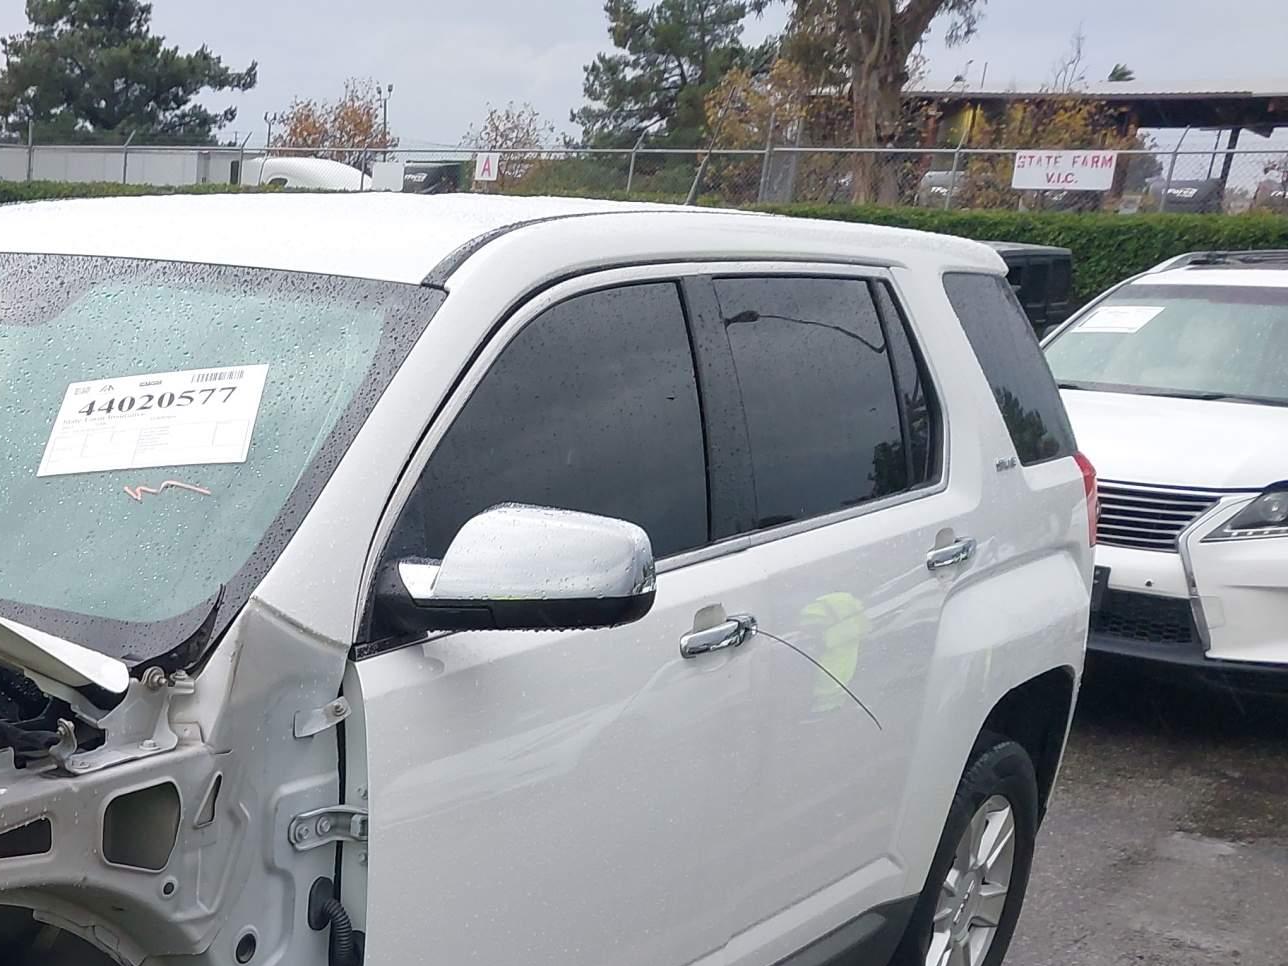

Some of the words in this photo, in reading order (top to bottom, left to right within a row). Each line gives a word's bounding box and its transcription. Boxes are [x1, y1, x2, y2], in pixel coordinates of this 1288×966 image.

[480, 155, 491, 177] A
[1017, 154, 1063, 169] STATE
[1072, 154, 1113, 169] FARM
[1046, 172, 1079, 185] V.I.C.
[77, 386, 238, 417] 44020577
